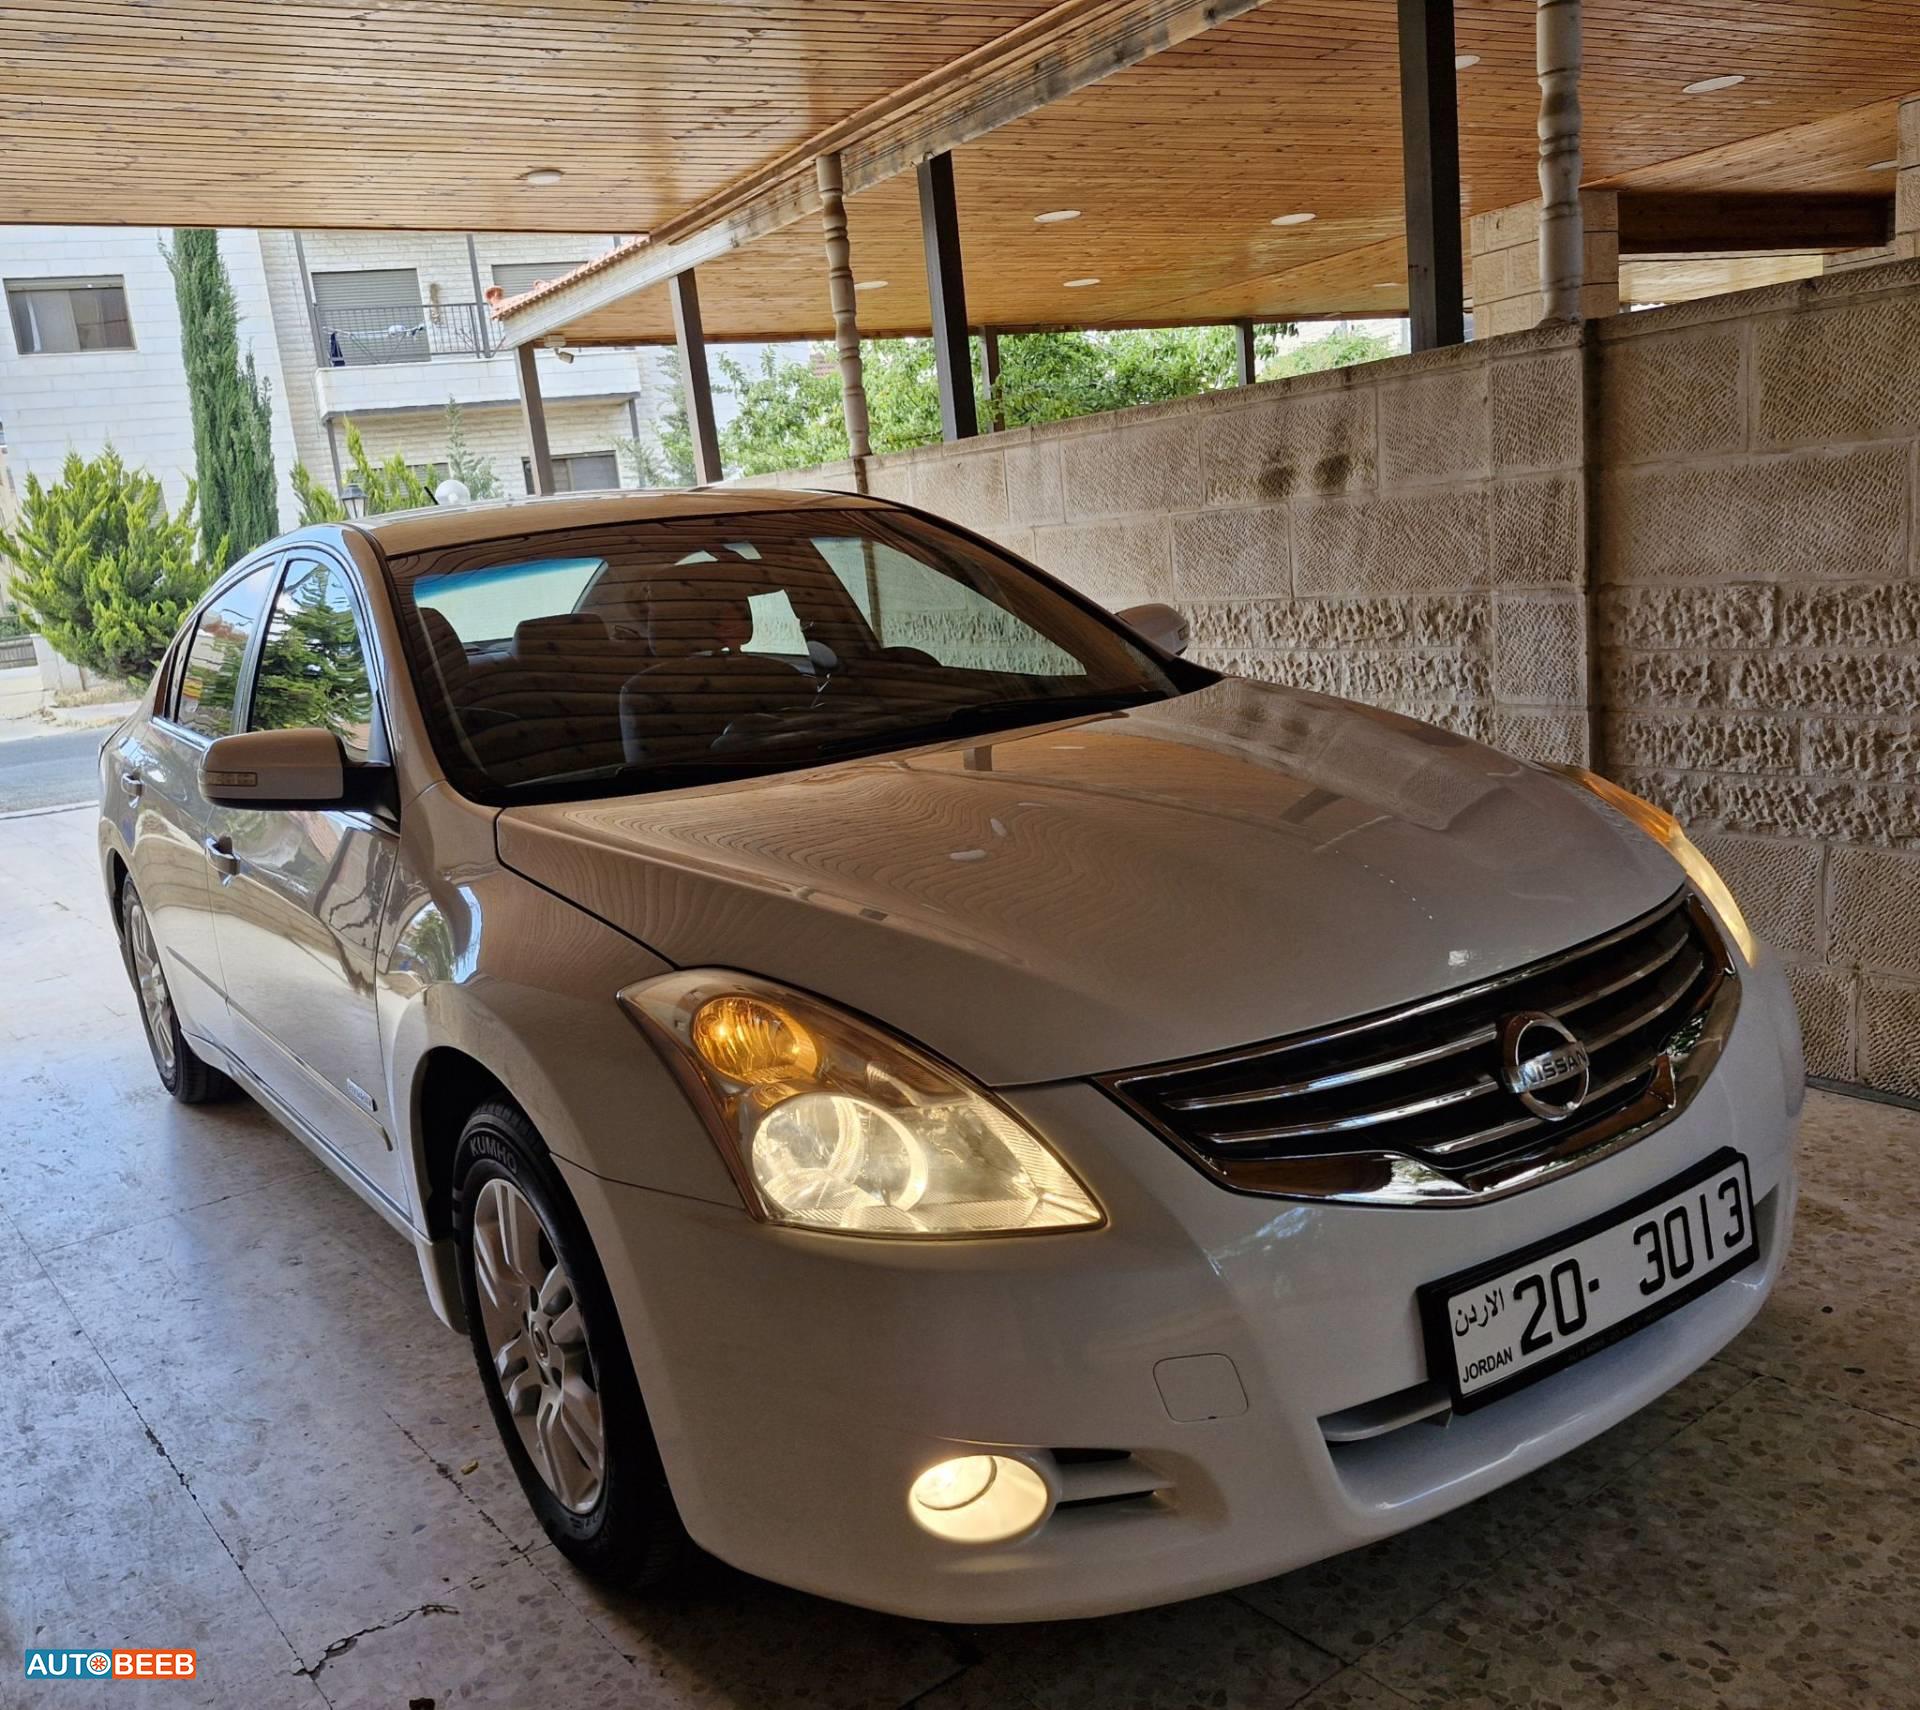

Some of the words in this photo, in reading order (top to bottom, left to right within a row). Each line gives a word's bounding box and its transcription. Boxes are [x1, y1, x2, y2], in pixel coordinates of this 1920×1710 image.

[1520, 1051, 1587, 1087] NISSAN
[470, 1135, 518, 1175] KUMHO
[1633, 1177, 1745, 1296] 3013
[1463, 1346, 1513, 1383] JORDAN
